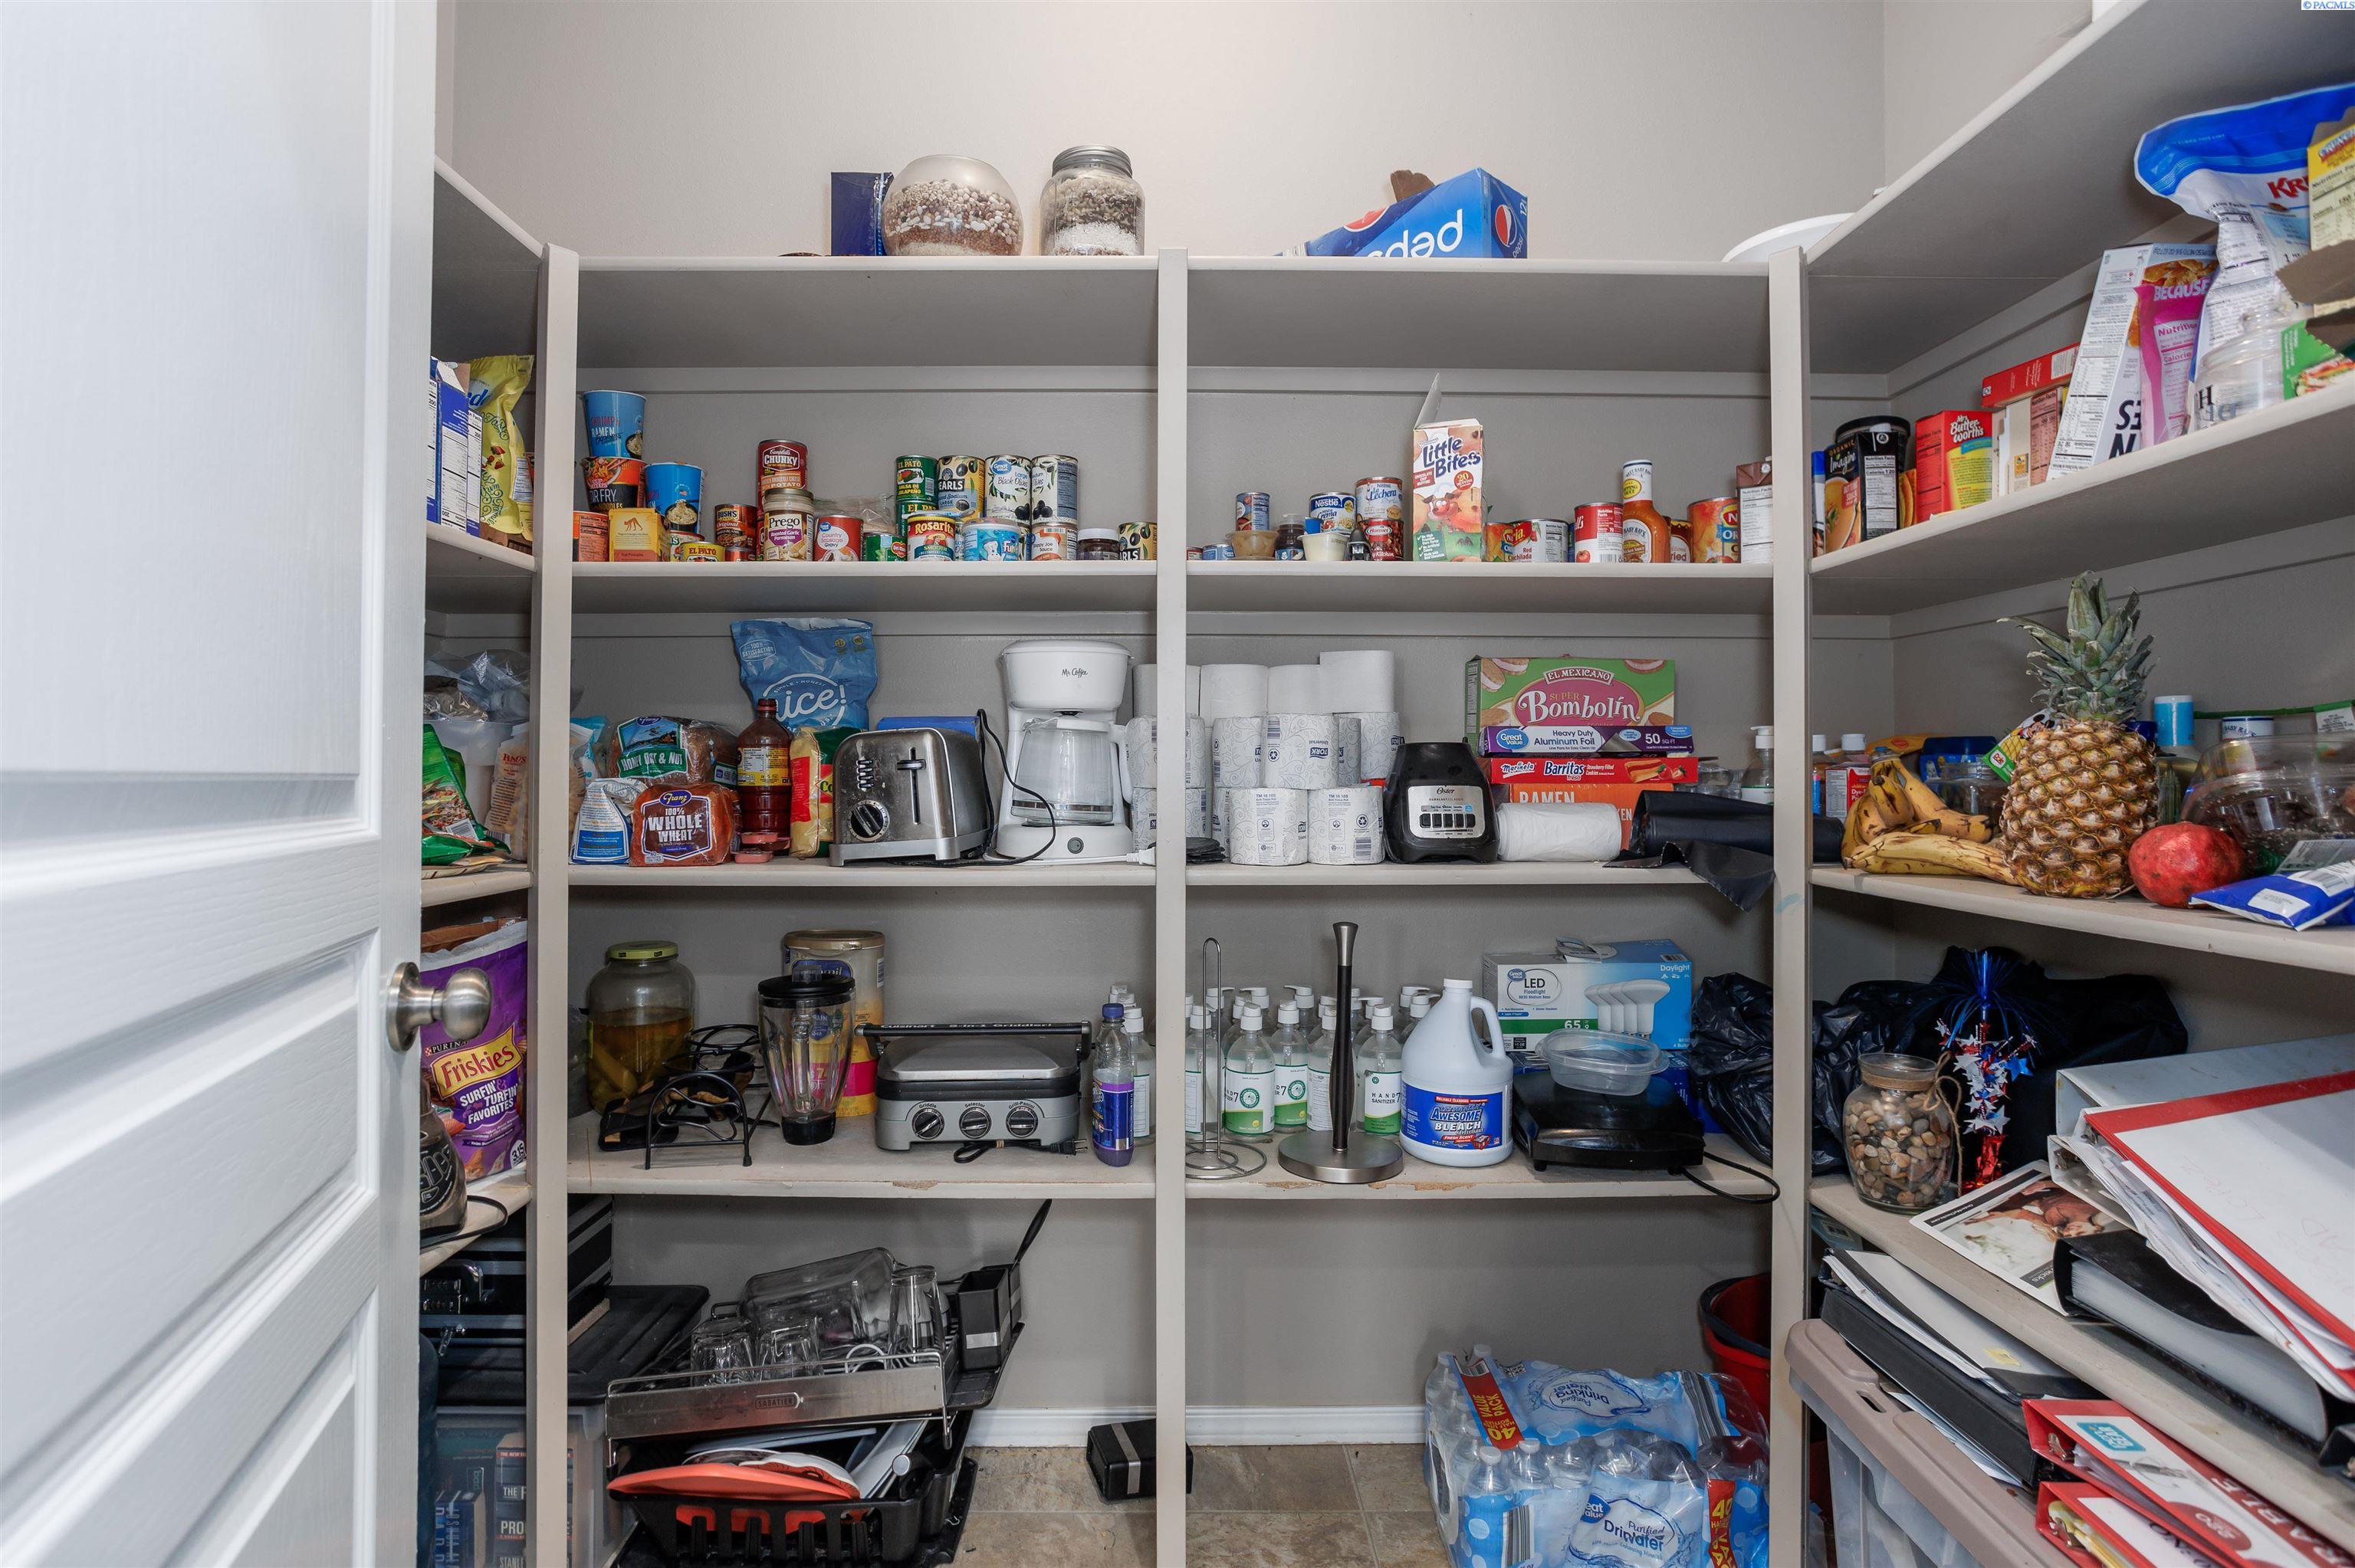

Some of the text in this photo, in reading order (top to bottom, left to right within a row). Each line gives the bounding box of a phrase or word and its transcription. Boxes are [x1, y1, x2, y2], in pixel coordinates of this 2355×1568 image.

[2154, 277, 2211, 301] BECAUSE
[591, 426, 615, 438] RAMEN
[1953, 426, 1985, 443] worth's
[1423, 437, 1463, 468] Little
[764, 454, 798, 466] CHUNKY
[1435, 452, 1481, 478] Bites
[997, 477, 1013, 485] Black
[1457, 473, 1469, 482] 20
[938, 481, 964, 490] EARLS
[1370, 489, 1397, 500] Lechera
[769, 517, 800, 530] Prego
[915, 520, 954, 535] Rosarita
[688, 547, 717, 556] EL PATO
[1670, 552, 1687, 561] ried
[1071, 668, 1089, 679] Coffee
[1548, 668, 1611, 681] EL MEXICANO
[1549, 692, 1581, 701] SUPER
[1518, 690, 1641, 723] Bombolín
[1500, 733, 1522, 742] Great
[1552, 730, 1594, 738] Heavy Duty
[1645, 733, 1660, 744] 50
[1534, 737, 1595, 746] Aluminum Foil
[1309, 747, 1329, 756] TORK
[620, 755, 642, 772] HONEY
[659, 752, 666, 764] &
[668, 752, 683, 765] NUT
[1544, 760, 1585, 776] Barritas
[663, 792, 688, 805] Franz
[665, 808, 685, 816] 100%
[648, 813, 703, 832] WHOLE
[658, 828, 693, 842] WHEAT
[1660, 964, 1690, 973] Daylight
[1524, 978, 1545, 989] LED
[1564, 1020, 1581, 1029] 65
[432, 1039, 468, 1055] PURINA
[441, 1045, 514, 1089] Friskies
[460, 1079, 497, 1107] SURFIN'
[483, 1082, 518, 1107] TURFIN'
[468, 1097, 514, 1125] FAVORITES
[1008, 1101, 1036, 1110] Grill-Panini
[1430, 1106, 1483, 1121] AWESOME
[1434, 1120, 1482, 1132] BLEACH
[1552, 1379, 1593, 1394] Water
[1555, 1386, 1611, 1406] Drinking
[1473, 1394, 1492, 1418] VALUE
[1487, 1393, 1506, 1418] PACK
[1487, 1427, 1516, 1441] 40
[503, 1487, 517, 1497] THE
[1586, 1502, 1604, 1514] eat
[2210, 1466, 2353, 1568] RABLE
[1628, 1520, 1666, 1536] Purified
[499, 1557, 525, 1568] STANLE
